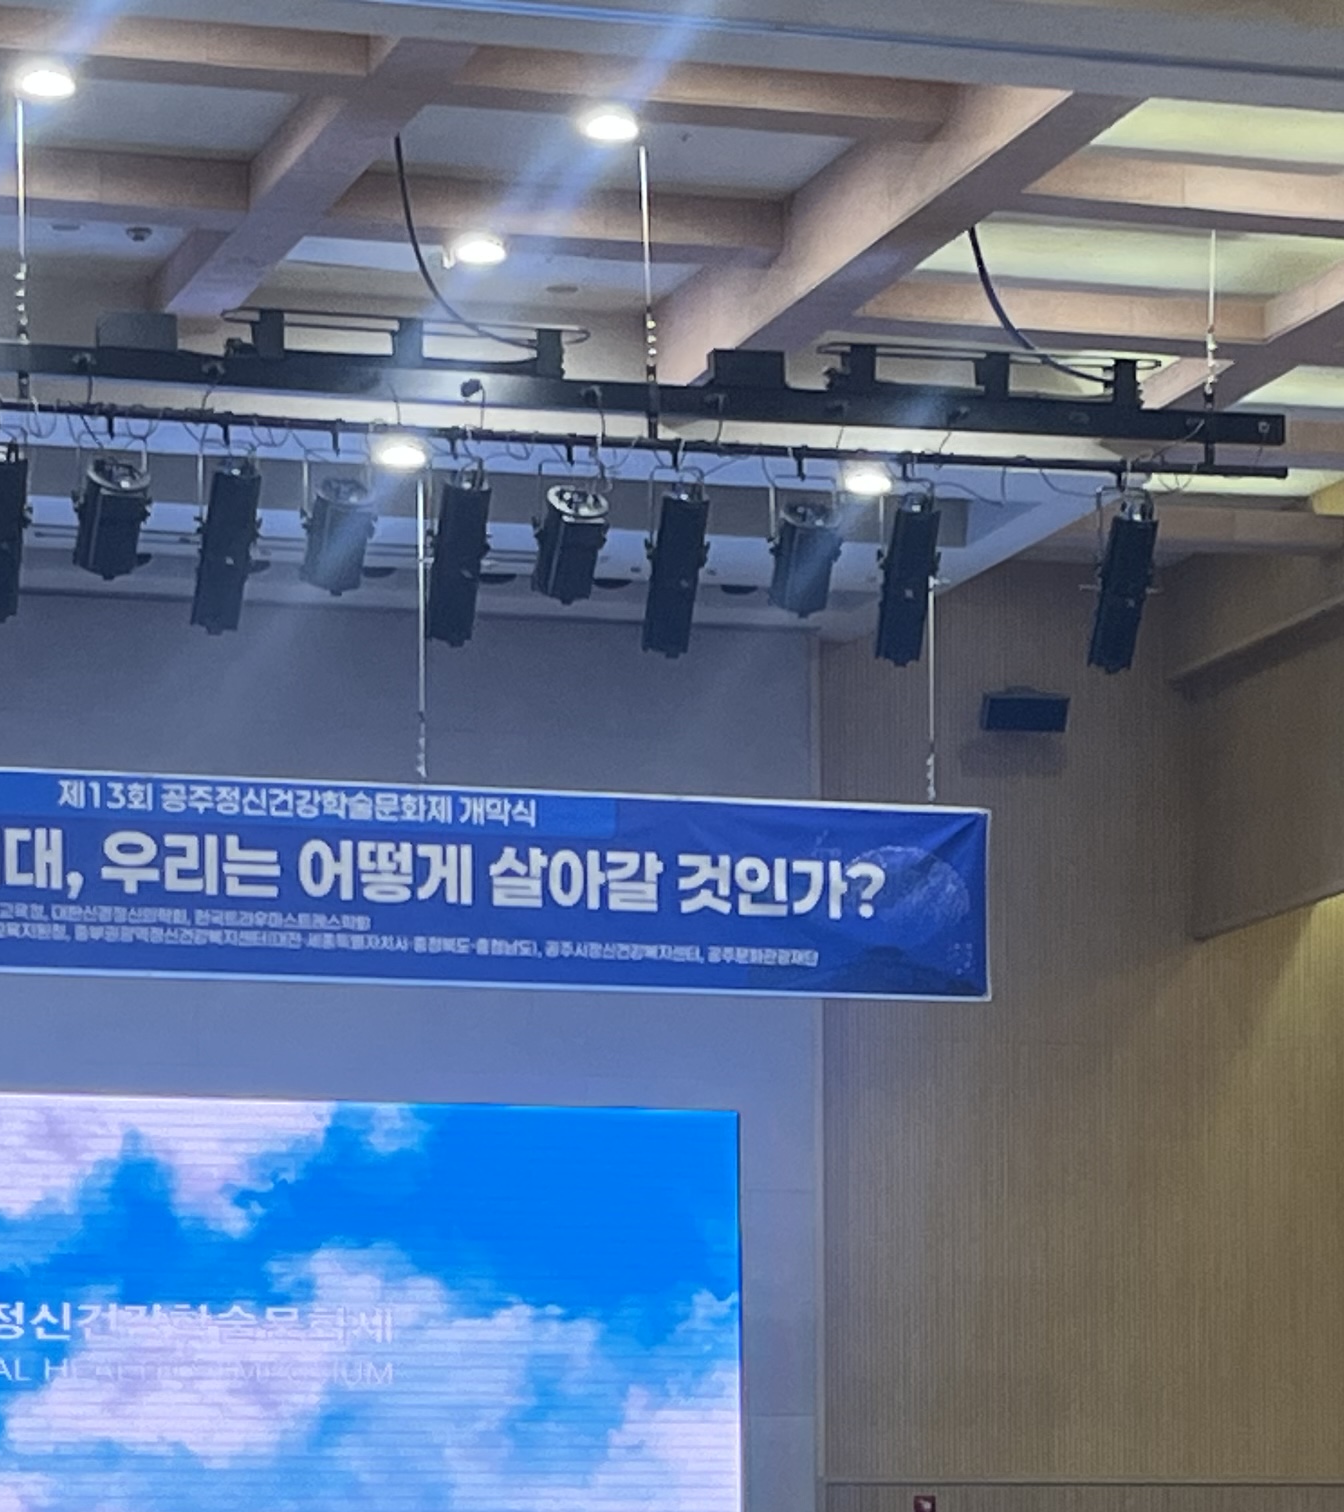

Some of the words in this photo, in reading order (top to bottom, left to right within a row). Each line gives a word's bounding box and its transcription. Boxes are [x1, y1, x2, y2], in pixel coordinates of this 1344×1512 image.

[58, 779, 152, 812] 제13회
[161, 783, 451, 824] 공주정신건강학술문화제
[460, 795, 536, 828] 개막식
[100, 830, 281, 898] 우리는
[297, 838, 472, 905] 어떻게
[489, 845, 663, 912] 살아갈
[677, 853, 885, 920] 것인가?
